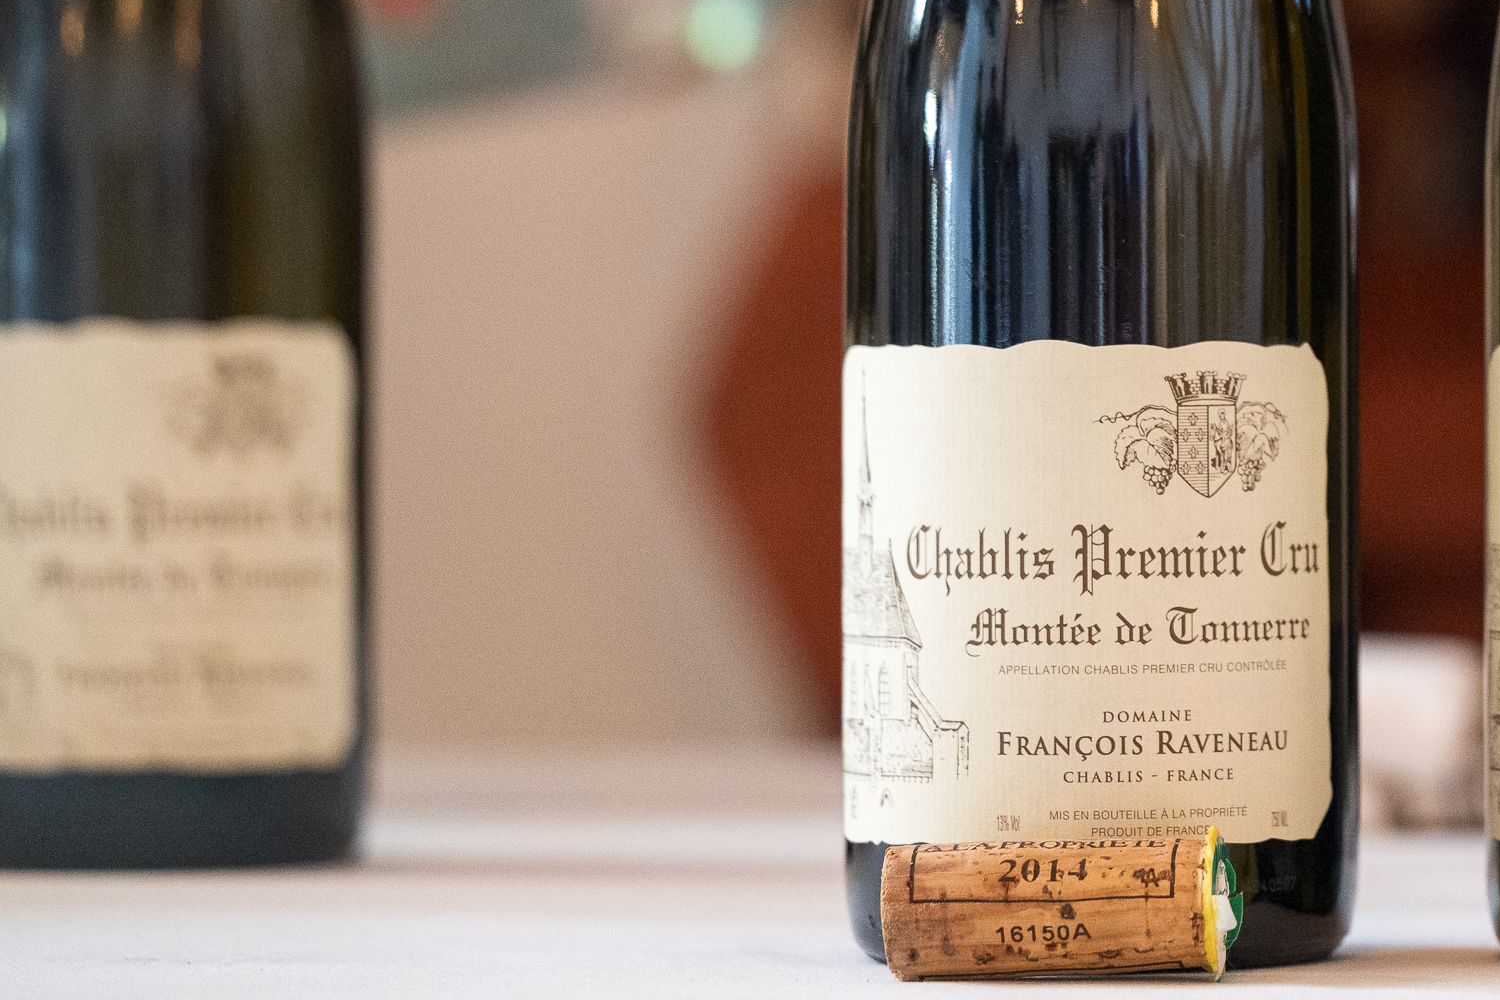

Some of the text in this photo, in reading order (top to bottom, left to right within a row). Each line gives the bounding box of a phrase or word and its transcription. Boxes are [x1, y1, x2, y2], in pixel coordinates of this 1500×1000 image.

[907, 521, 1319, 596] Chablis Premier Cru
[965, 606, 1310, 657] Montée de Tonnerre
[998, 658, 1287, 675] APPELLATION CHABLIS PREMIER CRU CONTRÔLÉE
[1103, 709, 1192, 723] DOMAINE
[998, 728, 1288, 761] FRANÇOIS RAVENEAU
[1063, 770, 1144, 784] CHABLIS
[1167, 768, 1234, 782] FRANCE
[1049, 806, 1248, 821] MIS EN BOUTEILLE À LA PROPRIÉTÉ
[1091, 826, 1210, 837] PRODUIT DE FRANCE
[998, 858, 1088, 883] 2014
[995, 923, 1092, 944] 16150A
